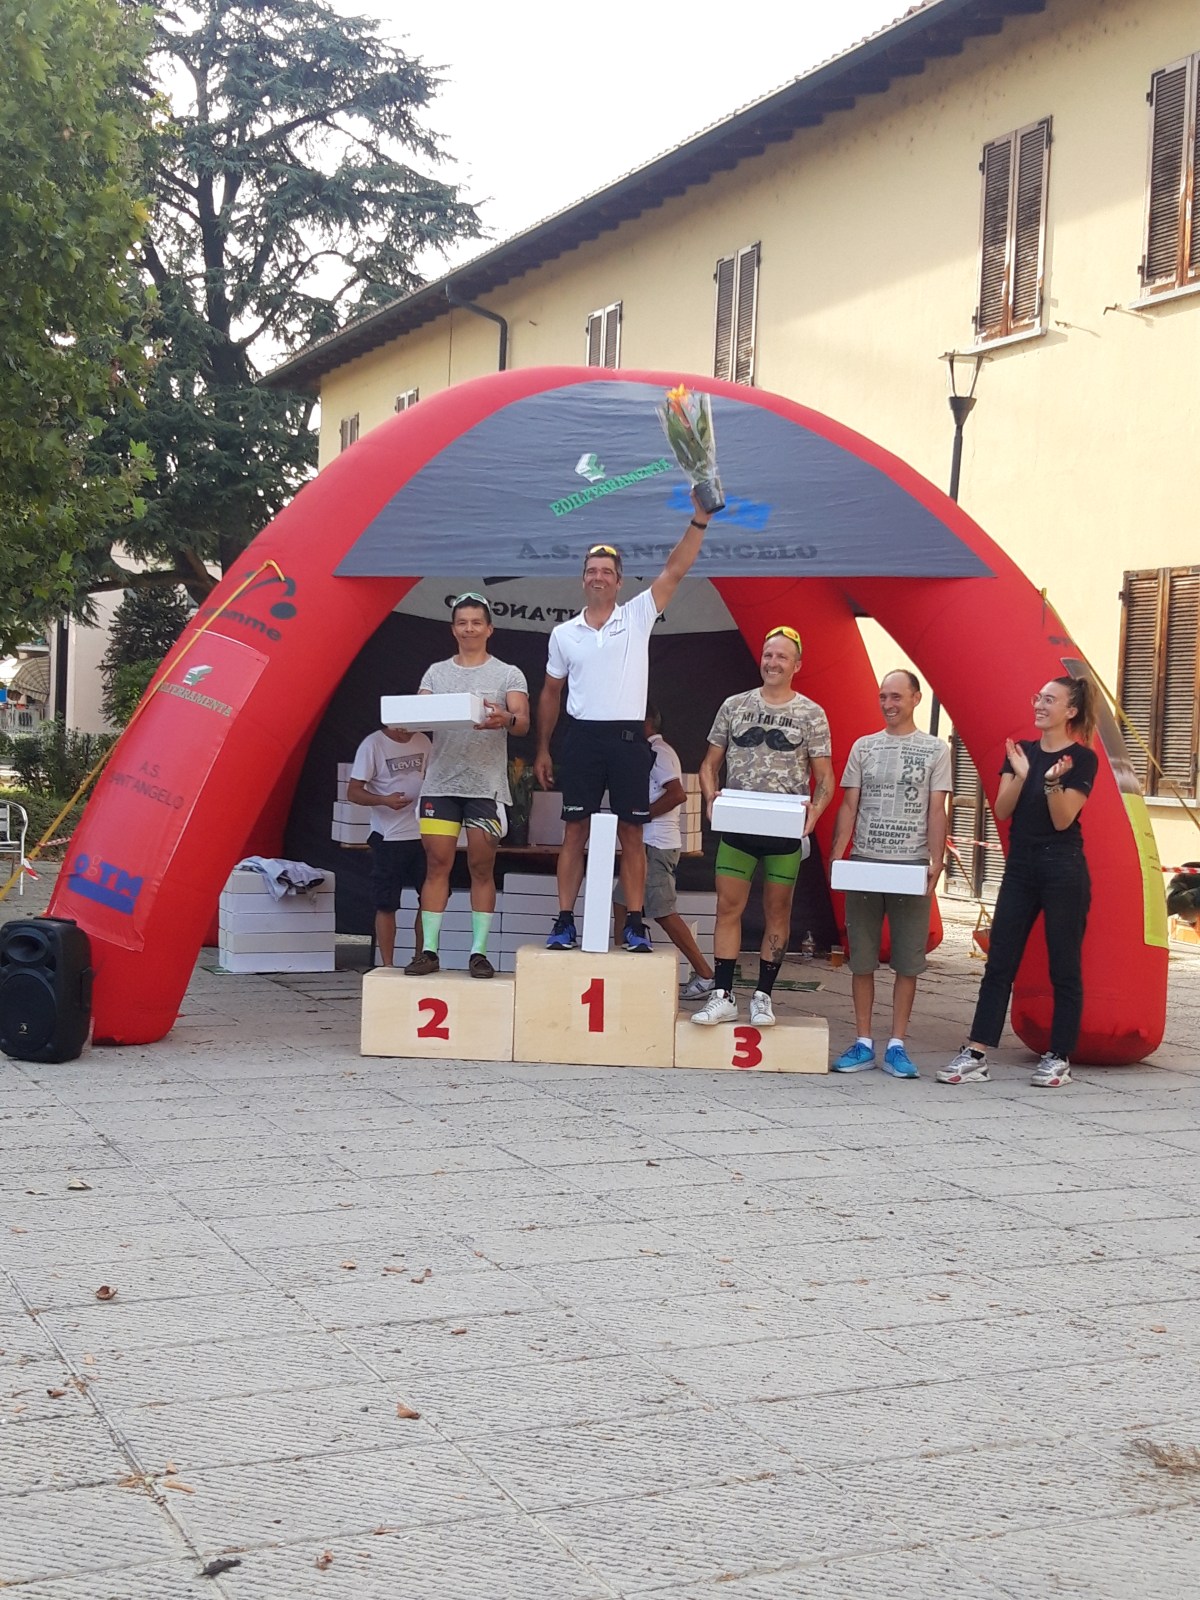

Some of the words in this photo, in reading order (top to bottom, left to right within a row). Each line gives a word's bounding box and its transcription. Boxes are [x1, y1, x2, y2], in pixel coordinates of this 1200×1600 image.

[515, 542, 580, 560] A.S.
[900, 764, 926, 783] 23
[868, 830, 911, 839] RESIDENTS
[869, 822, 918, 833] GUAYAMARE
[867, 837, 887, 845] LOSE
[581, 978, 605, 1033] 1
[417, 997, 450, 1041] 2
[731, 1026, 763, 1068] 3
